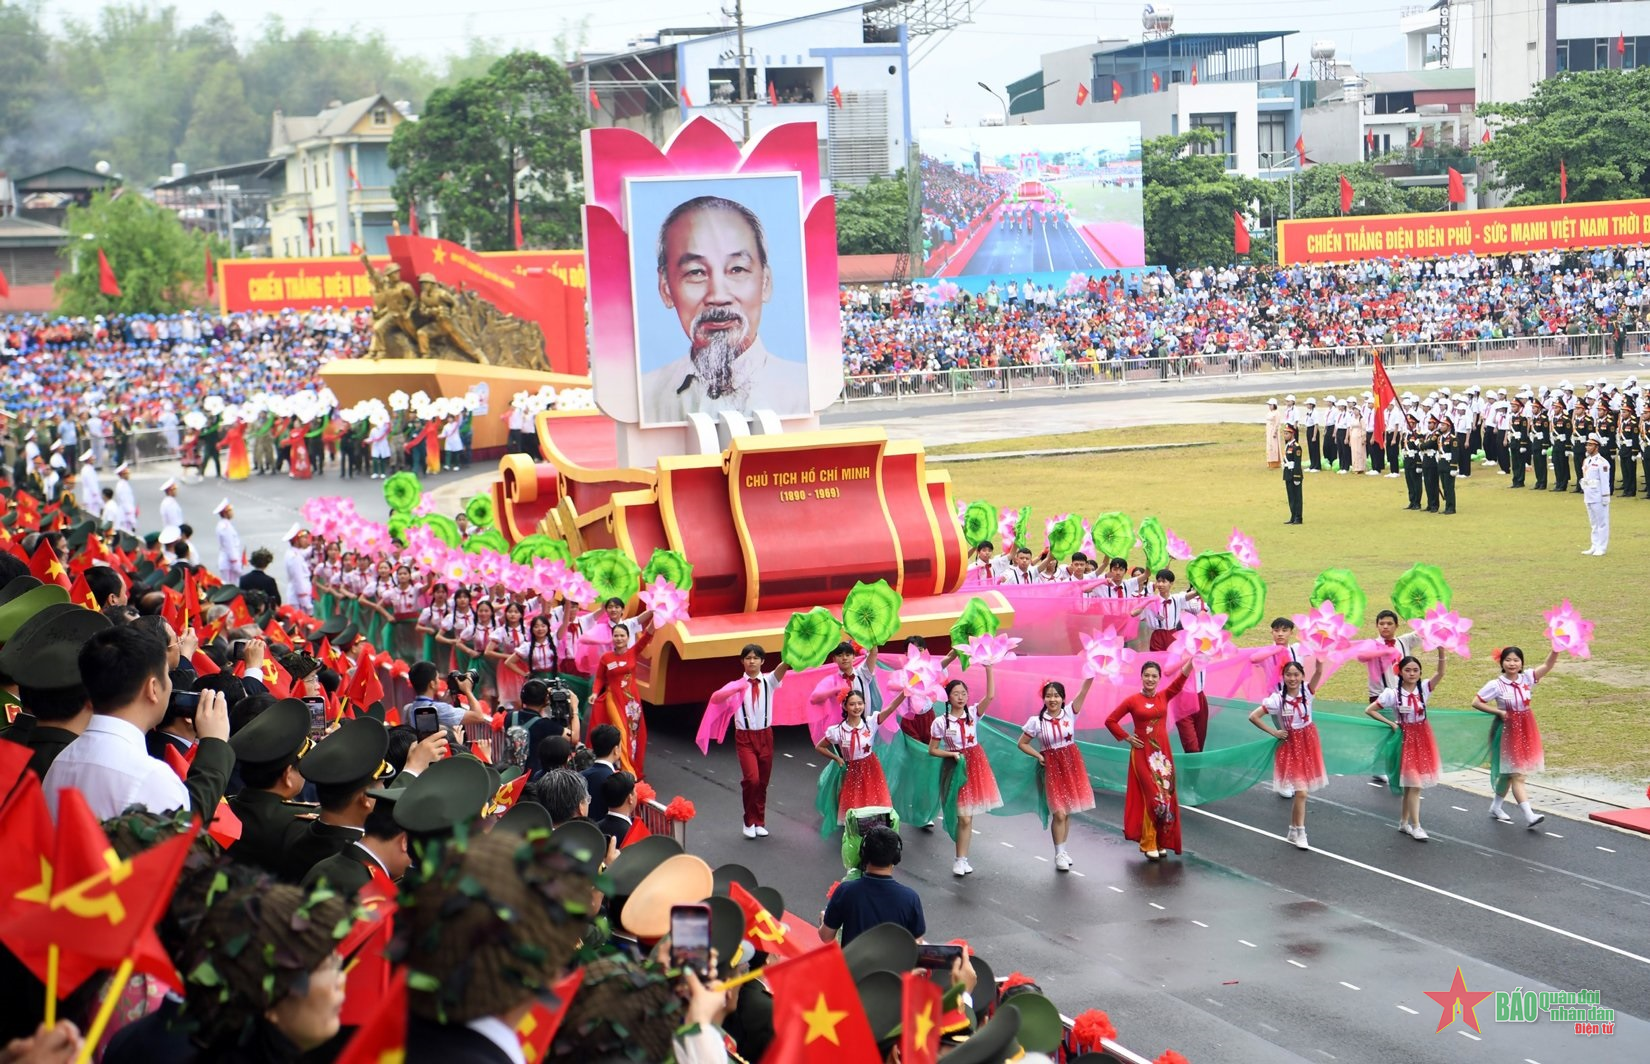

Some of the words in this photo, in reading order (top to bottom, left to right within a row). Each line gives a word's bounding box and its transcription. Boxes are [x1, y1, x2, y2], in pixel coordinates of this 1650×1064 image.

[1307, 227, 1342, 253] CHIẾN
[1344, 225, 1383, 251] THẮNG
[1386, 227, 1414, 253] ĐIỆN
[1417, 225, 1444, 247] BIÊN
[1447, 220, 1472, 246] PHỦ
[1483, 221, 1508, 244] SỨC
[1511, 221, 1547, 245] MẠNH
[1551, 216, 1576, 243] VIỆT
[1580, 217, 1608, 238] NAM
[1612, 211, 1640, 236] THỜI
[353, 271, 372, 297] BIÊ
[746, 471, 768, 487] CHỦ
[773, 472, 797, 487] TỊCH
[801, 467, 816, 483] HỒ
[820, 467, 838, 481] CHÍ
[841, 466, 870, 480] MINH
[780, 490, 806, 502] (1890
[815, 487, 840, 499] 1969)
